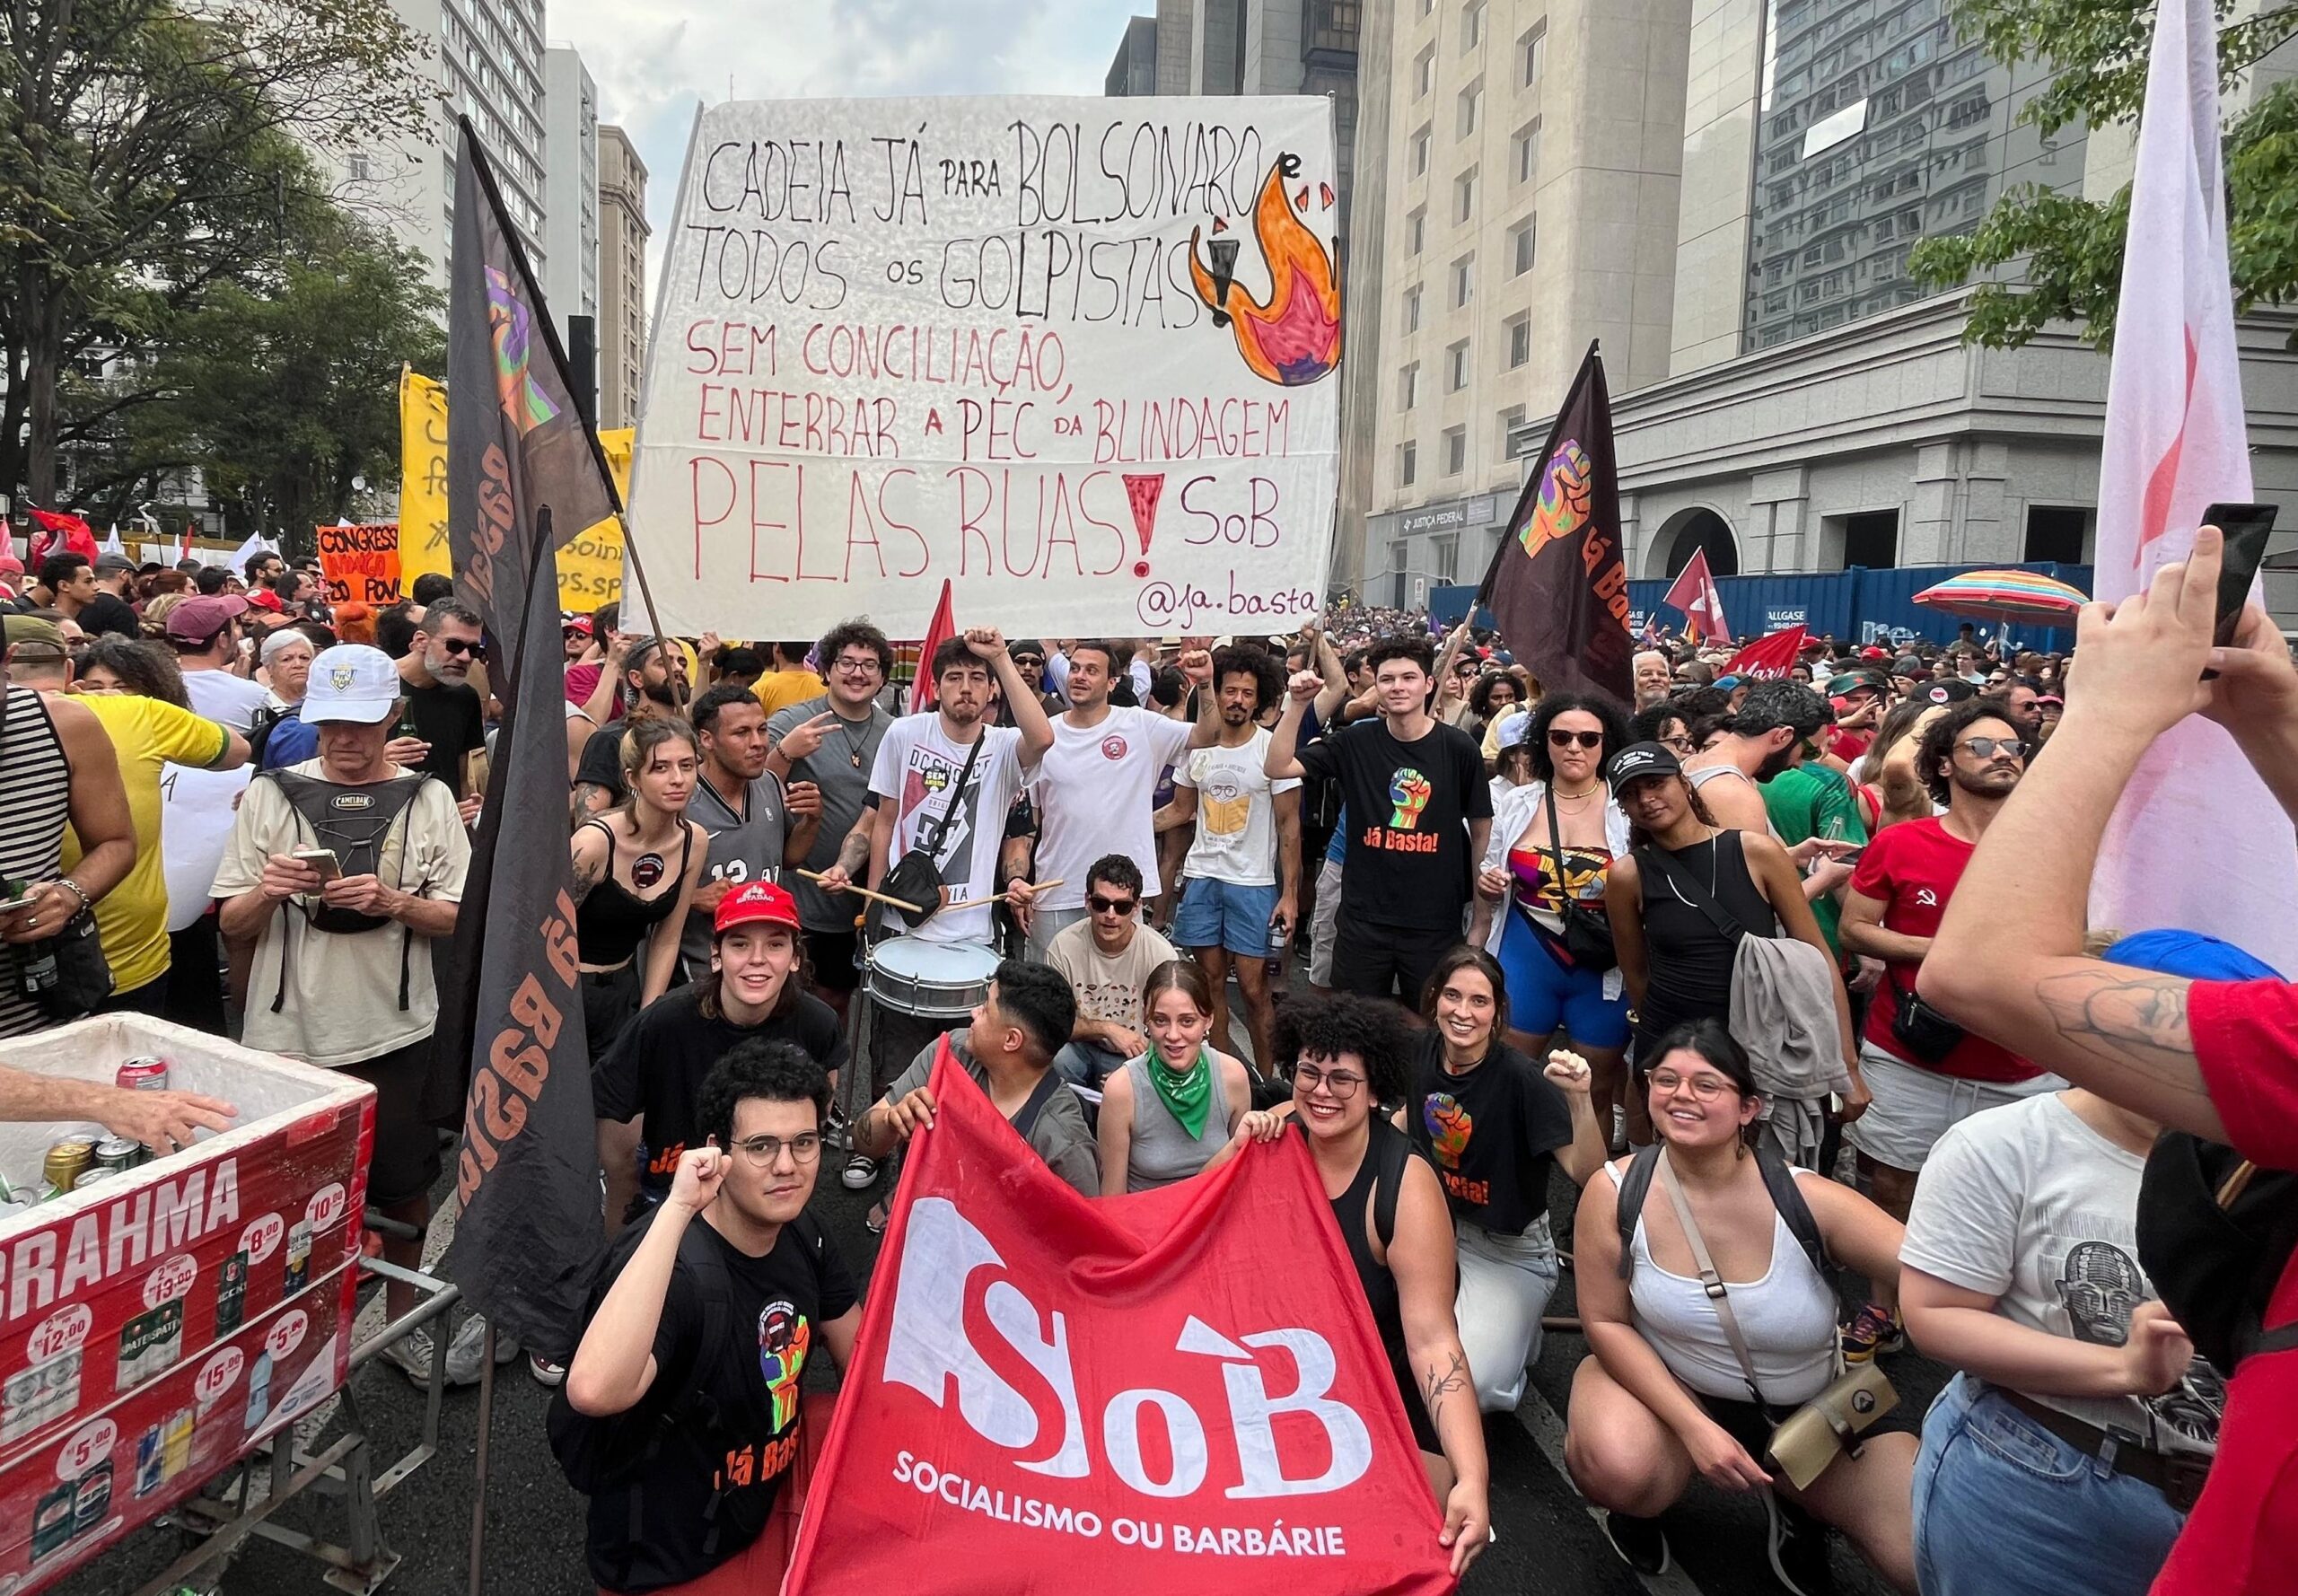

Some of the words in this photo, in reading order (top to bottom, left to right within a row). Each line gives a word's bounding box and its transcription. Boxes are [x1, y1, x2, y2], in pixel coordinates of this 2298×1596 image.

[704, 140, 854, 224] CADEIA
[870, 120, 929, 226] JÁ
[938, 157, 1002, 198] PARA
[1007, 119, 1263, 226] BOLSONARO
[1278, 151, 1301, 179] e
[687, 224, 847, 311] TODOS
[885, 259, 925, 285] os
[938, 230, 1199, 330] GOLPISTAS
[687, 321, 777, 378] SEM
[803, 323, 1075, 405] CONCILIAÇÃO,
[697, 382, 899, 460] ENTERRAR
[924, 408, 943, 437] A
[956, 397, 1038, 462] PEC
[1053, 415, 1083, 437] DA
[1092, 397, 1291, 464] BLINDAGEM
[689, 456, 930, 583] PELAS
[946, 468, 1166, 580] RUAS!
[1413, 516, 1436, 529] JUSTIÇA
[1436, 510, 1463, 524] FEDERAL
[926, 771, 946, 781] SEM
[1364, 827, 1381, 847] Já
[1385, 829, 1440, 853] Basta!
[0, 1157, 240, 1324] RAHMA
[891, 1449, 1102, 1539] SOCIALISMO
[1110, 1517, 1164, 1550] OU
[1172, 1519, 1346, 1557] BARBÁRIE
